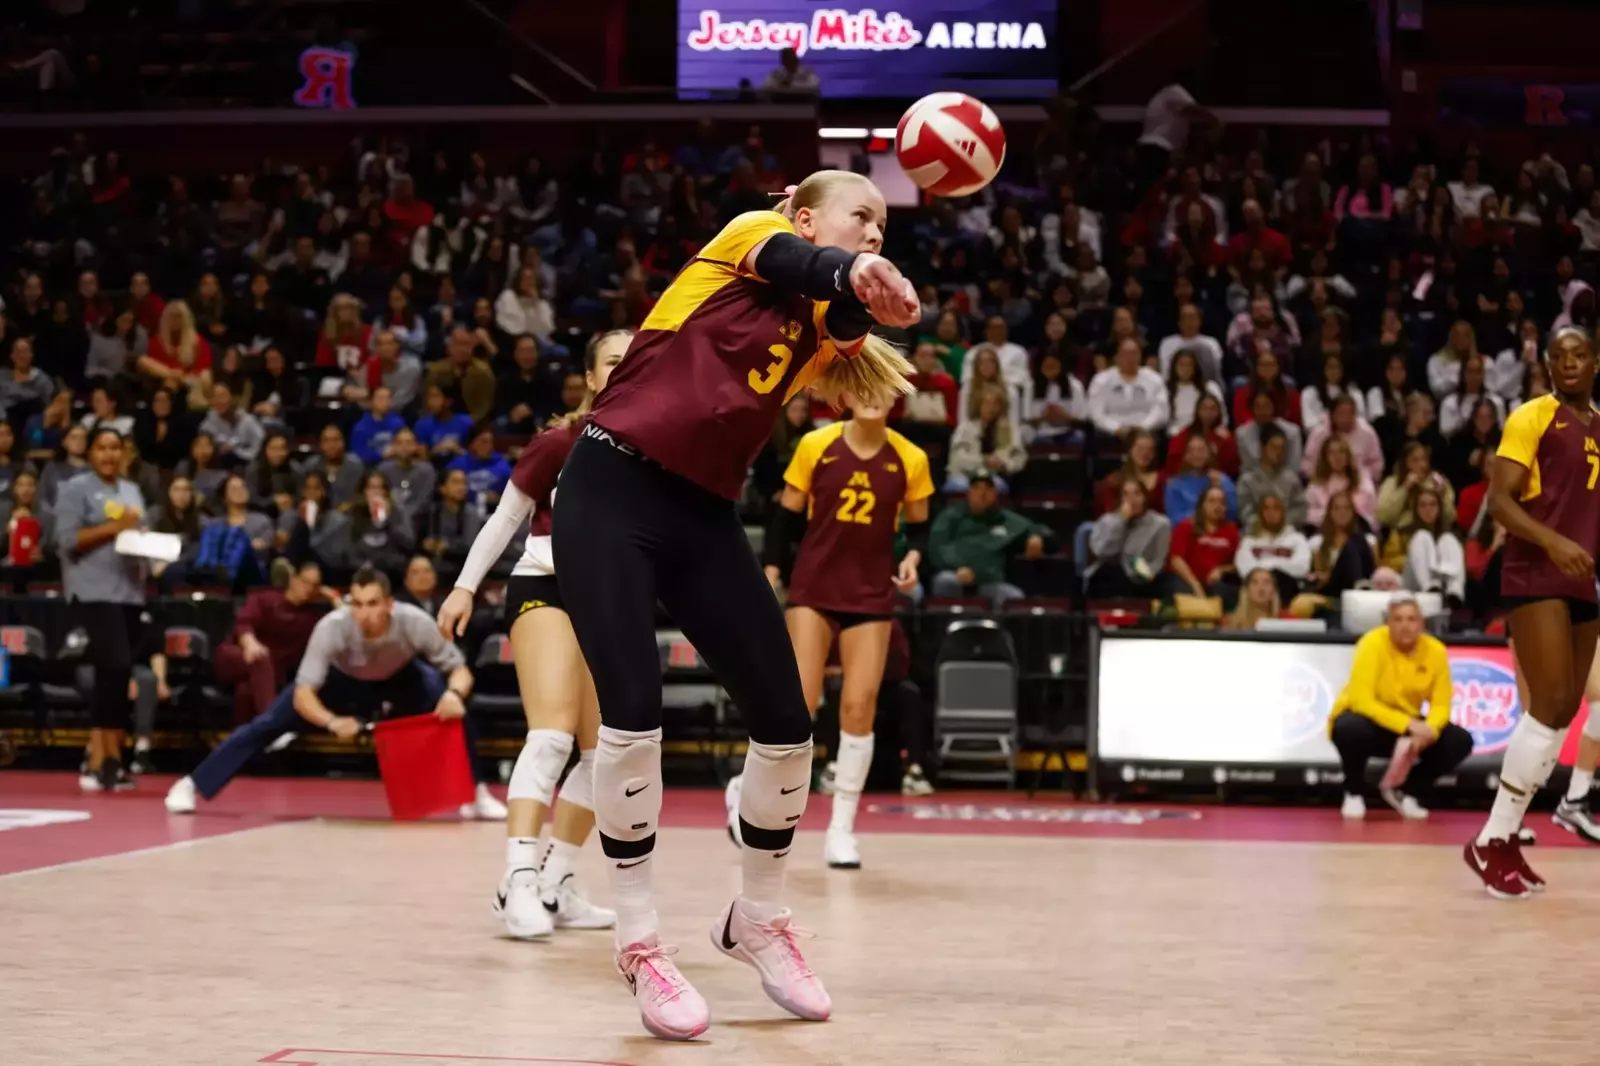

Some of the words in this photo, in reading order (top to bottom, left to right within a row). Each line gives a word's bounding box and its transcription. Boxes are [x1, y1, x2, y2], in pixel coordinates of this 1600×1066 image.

[688, 10, 806, 56] Jersey
[925, 22, 1047, 49] ARENA
[748, 344, 792, 394] 3
[836, 488, 876, 524] 22
